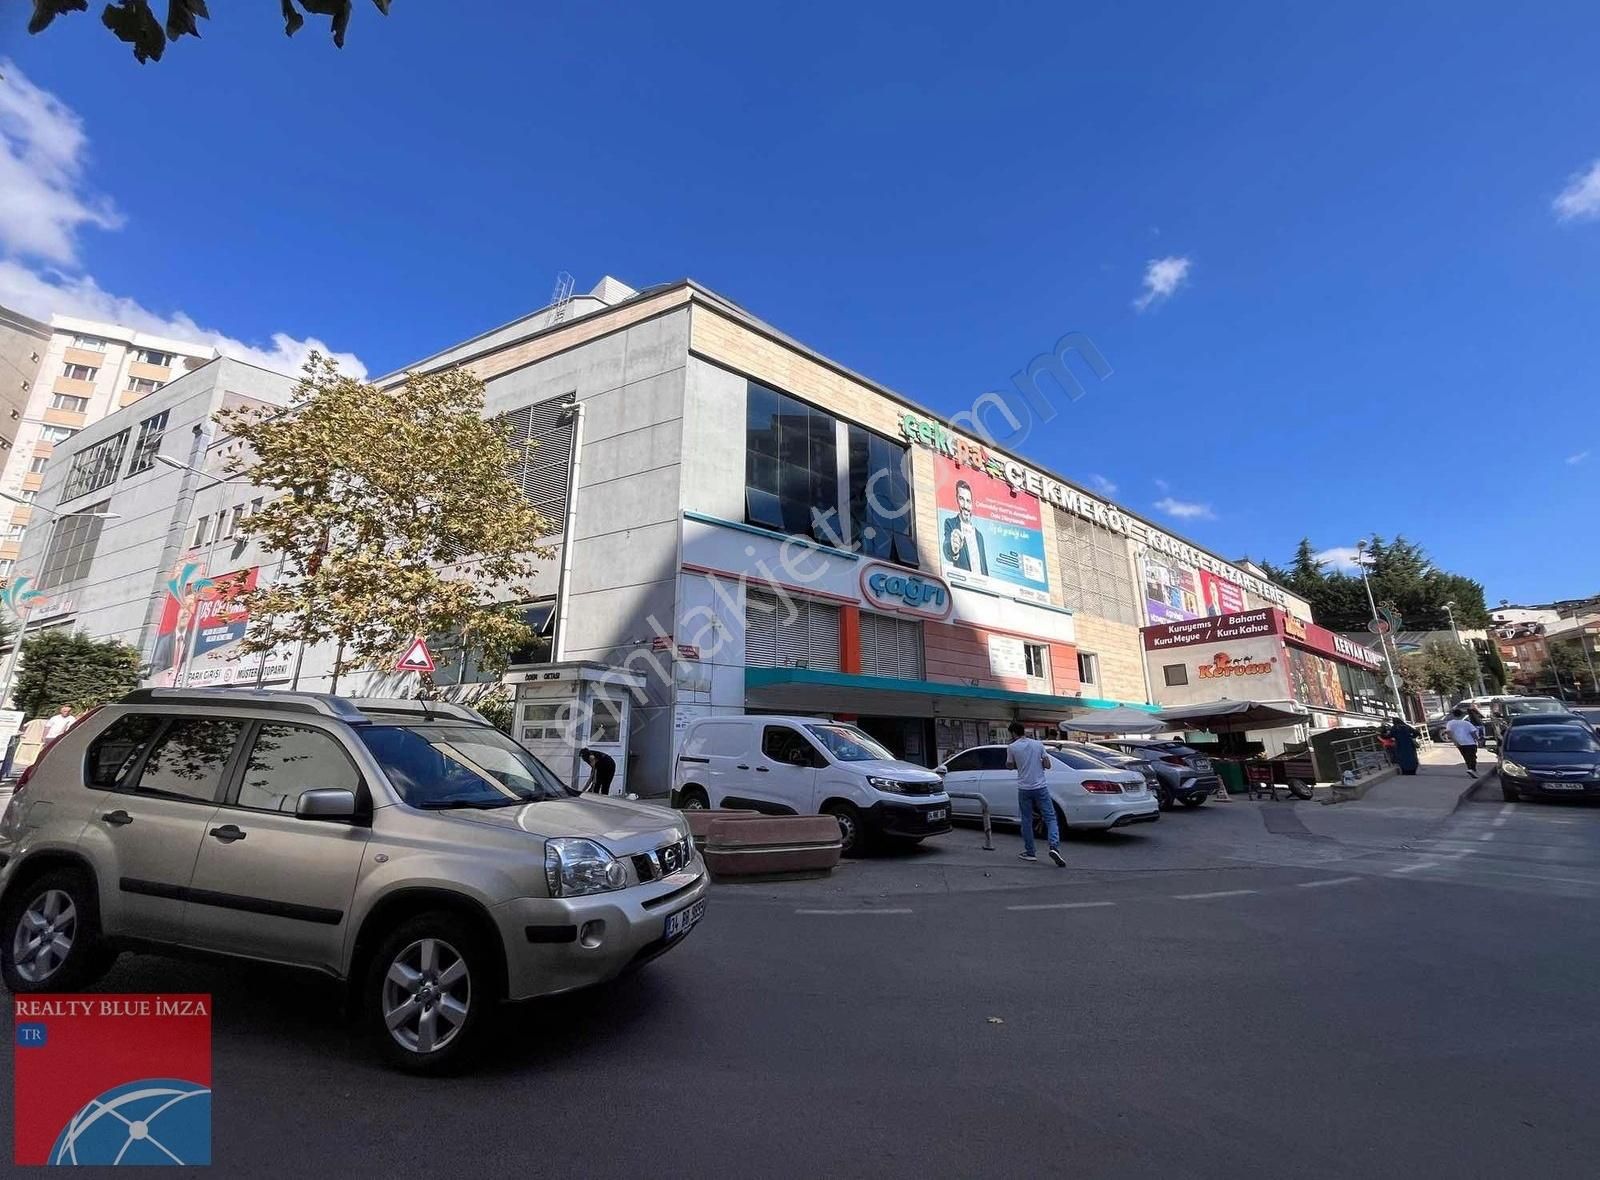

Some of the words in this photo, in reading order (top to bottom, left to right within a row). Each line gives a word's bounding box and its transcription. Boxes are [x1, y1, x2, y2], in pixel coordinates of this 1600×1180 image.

[1003, 460, 1132, 536] ÇEKMEKÖY
[1146, 527, 1203, 567] KAPALI
[1211, 559, 1251, 589] PAZAR
[869, 573, 945, 607] çağrı
[1229, 612, 1266, 625] Baharat
[1154, 636, 1173, 646] Kuru
[1217, 627, 1238, 638] Kuru
